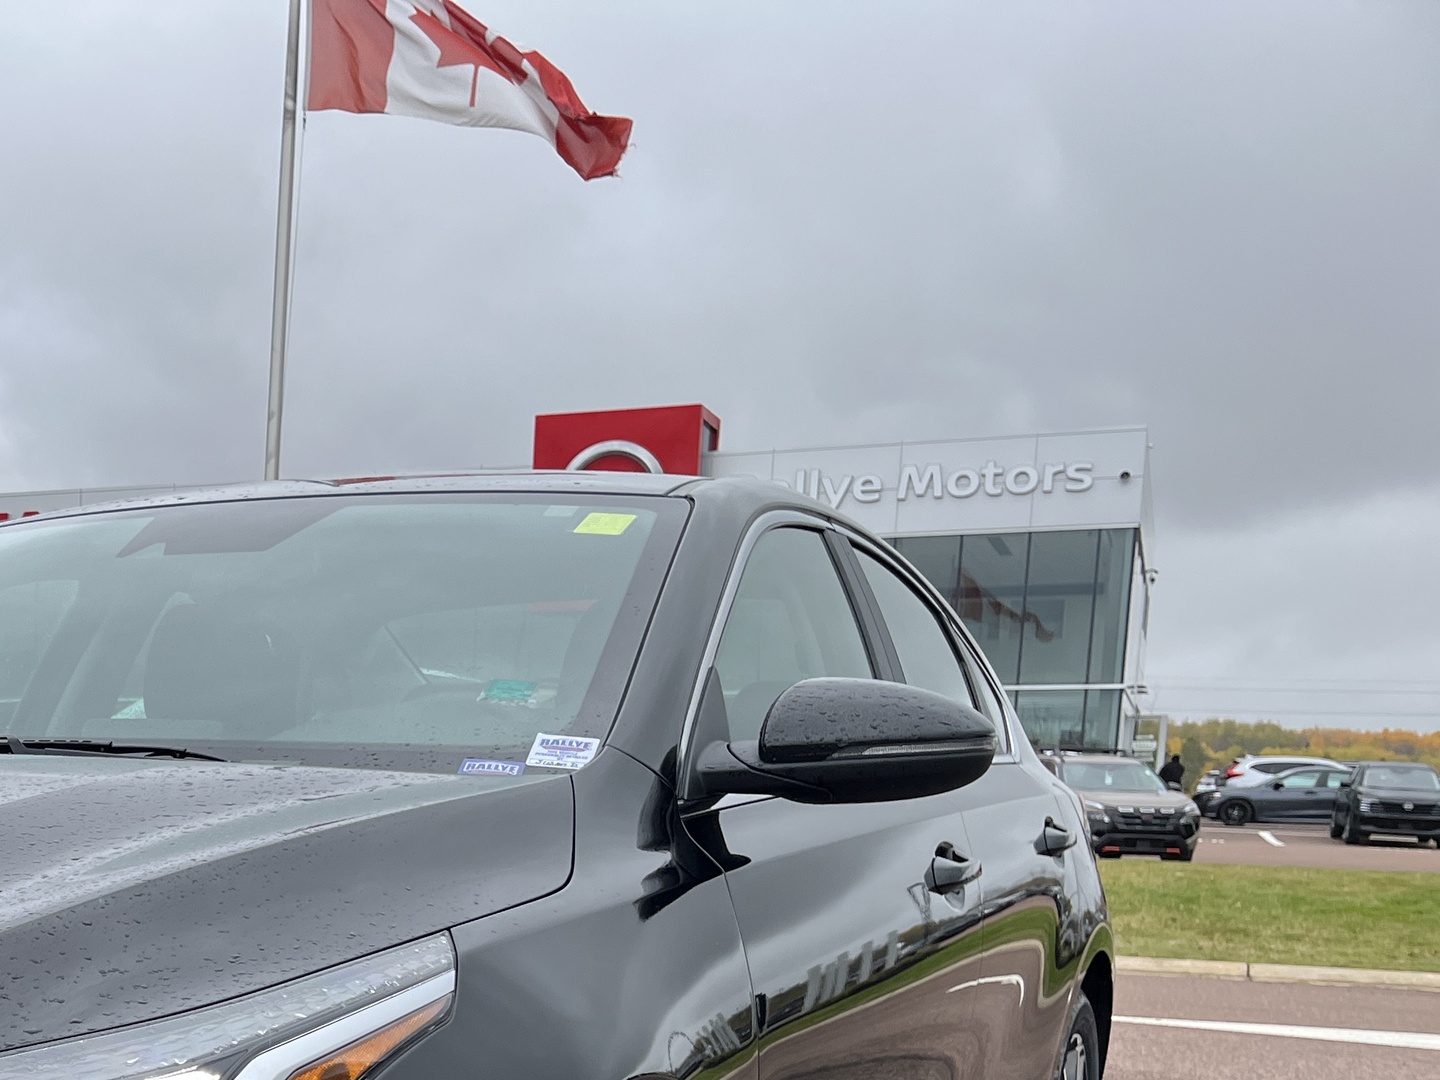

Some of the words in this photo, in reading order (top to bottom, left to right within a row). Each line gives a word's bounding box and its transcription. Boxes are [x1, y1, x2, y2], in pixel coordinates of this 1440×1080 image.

[772, 467, 883, 508] llye
[896, 458, 1094, 501] Motors
[540, 738, 592, 751] RALLYE
[464, 761, 519, 775] RALLYE
